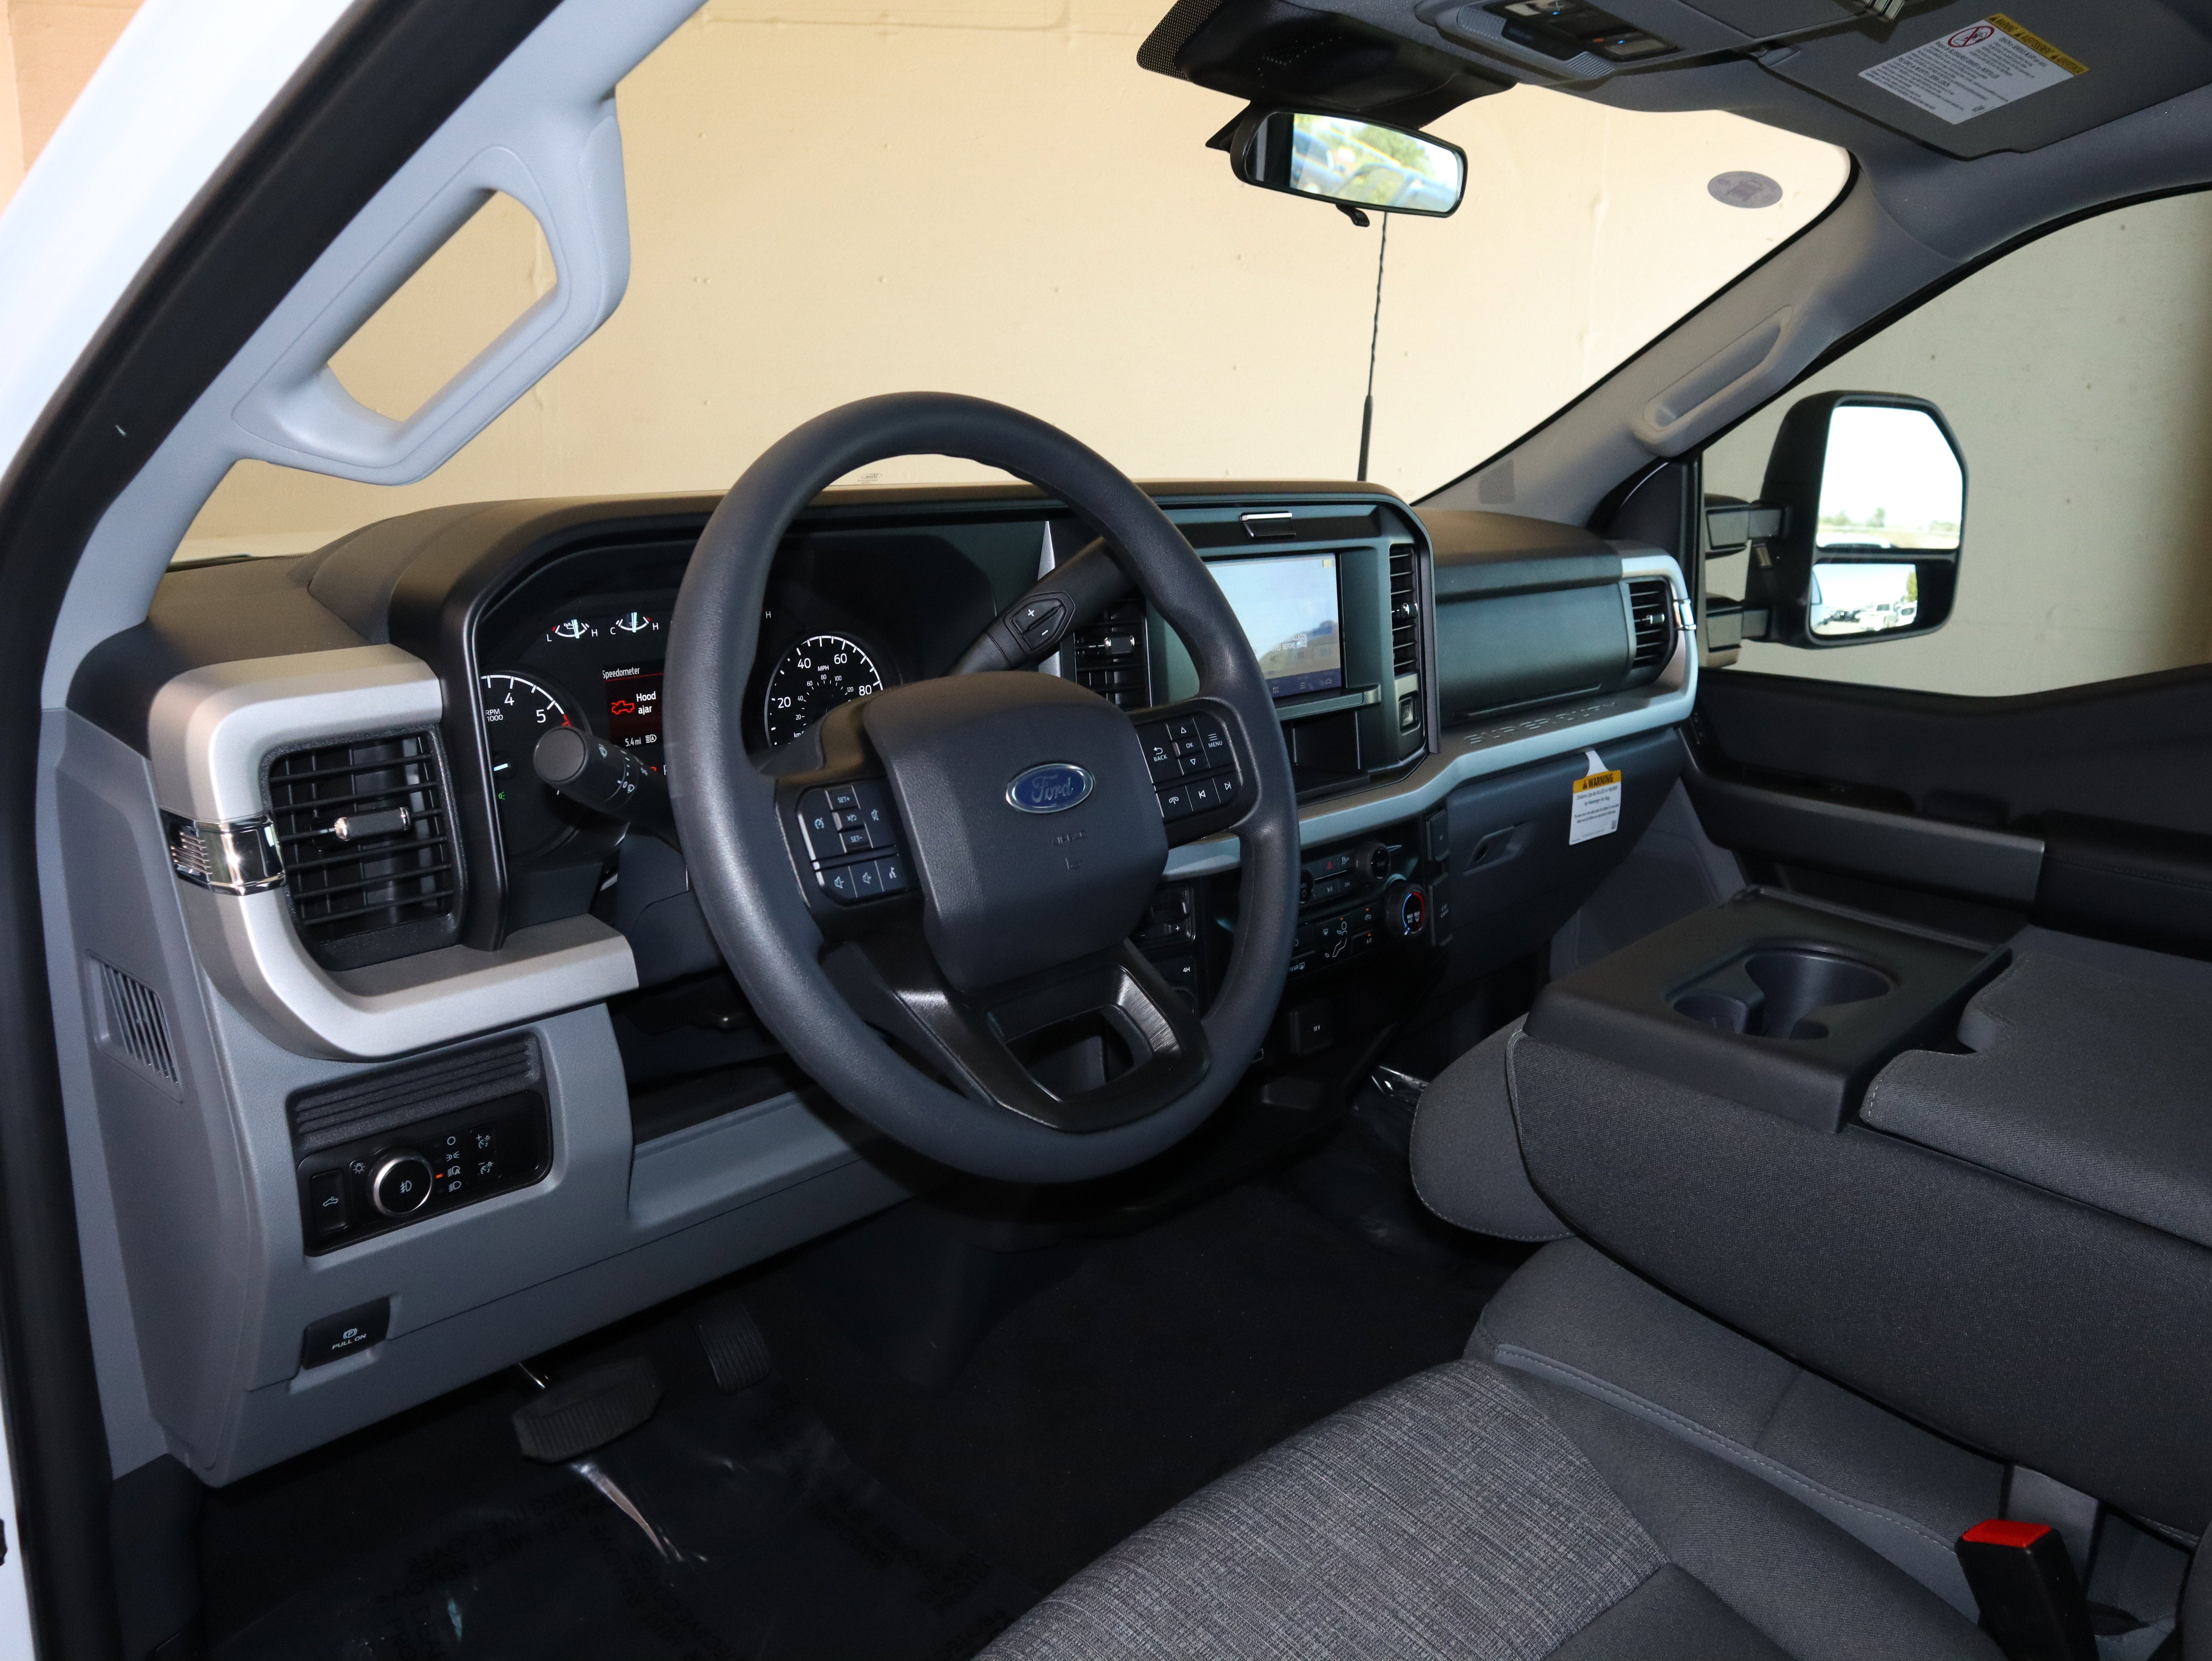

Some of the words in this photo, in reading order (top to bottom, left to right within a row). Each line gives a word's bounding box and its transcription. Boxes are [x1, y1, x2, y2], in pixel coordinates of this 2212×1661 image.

[591, 629, 598, 637] H
[798, 658, 811, 669] 40
[834, 653, 847, 664] 60
[602, 667, 640, 680] Speedometer
[859, 685, 872, 696] 80
[504, 693, 515, 706] 4
[636, 691, 656, 702] Hood
[777, 696, 791, 708] 20
[638, 705, 652, 715] ajar
[536, 709, 546, 723] 5
[625, 737, 634, 747] 5.4
[1588, 773, 1613, 788] WARNING
[1031, 774, 1074, 803] Ford
[332, 1339, 353, 1350] PULL
